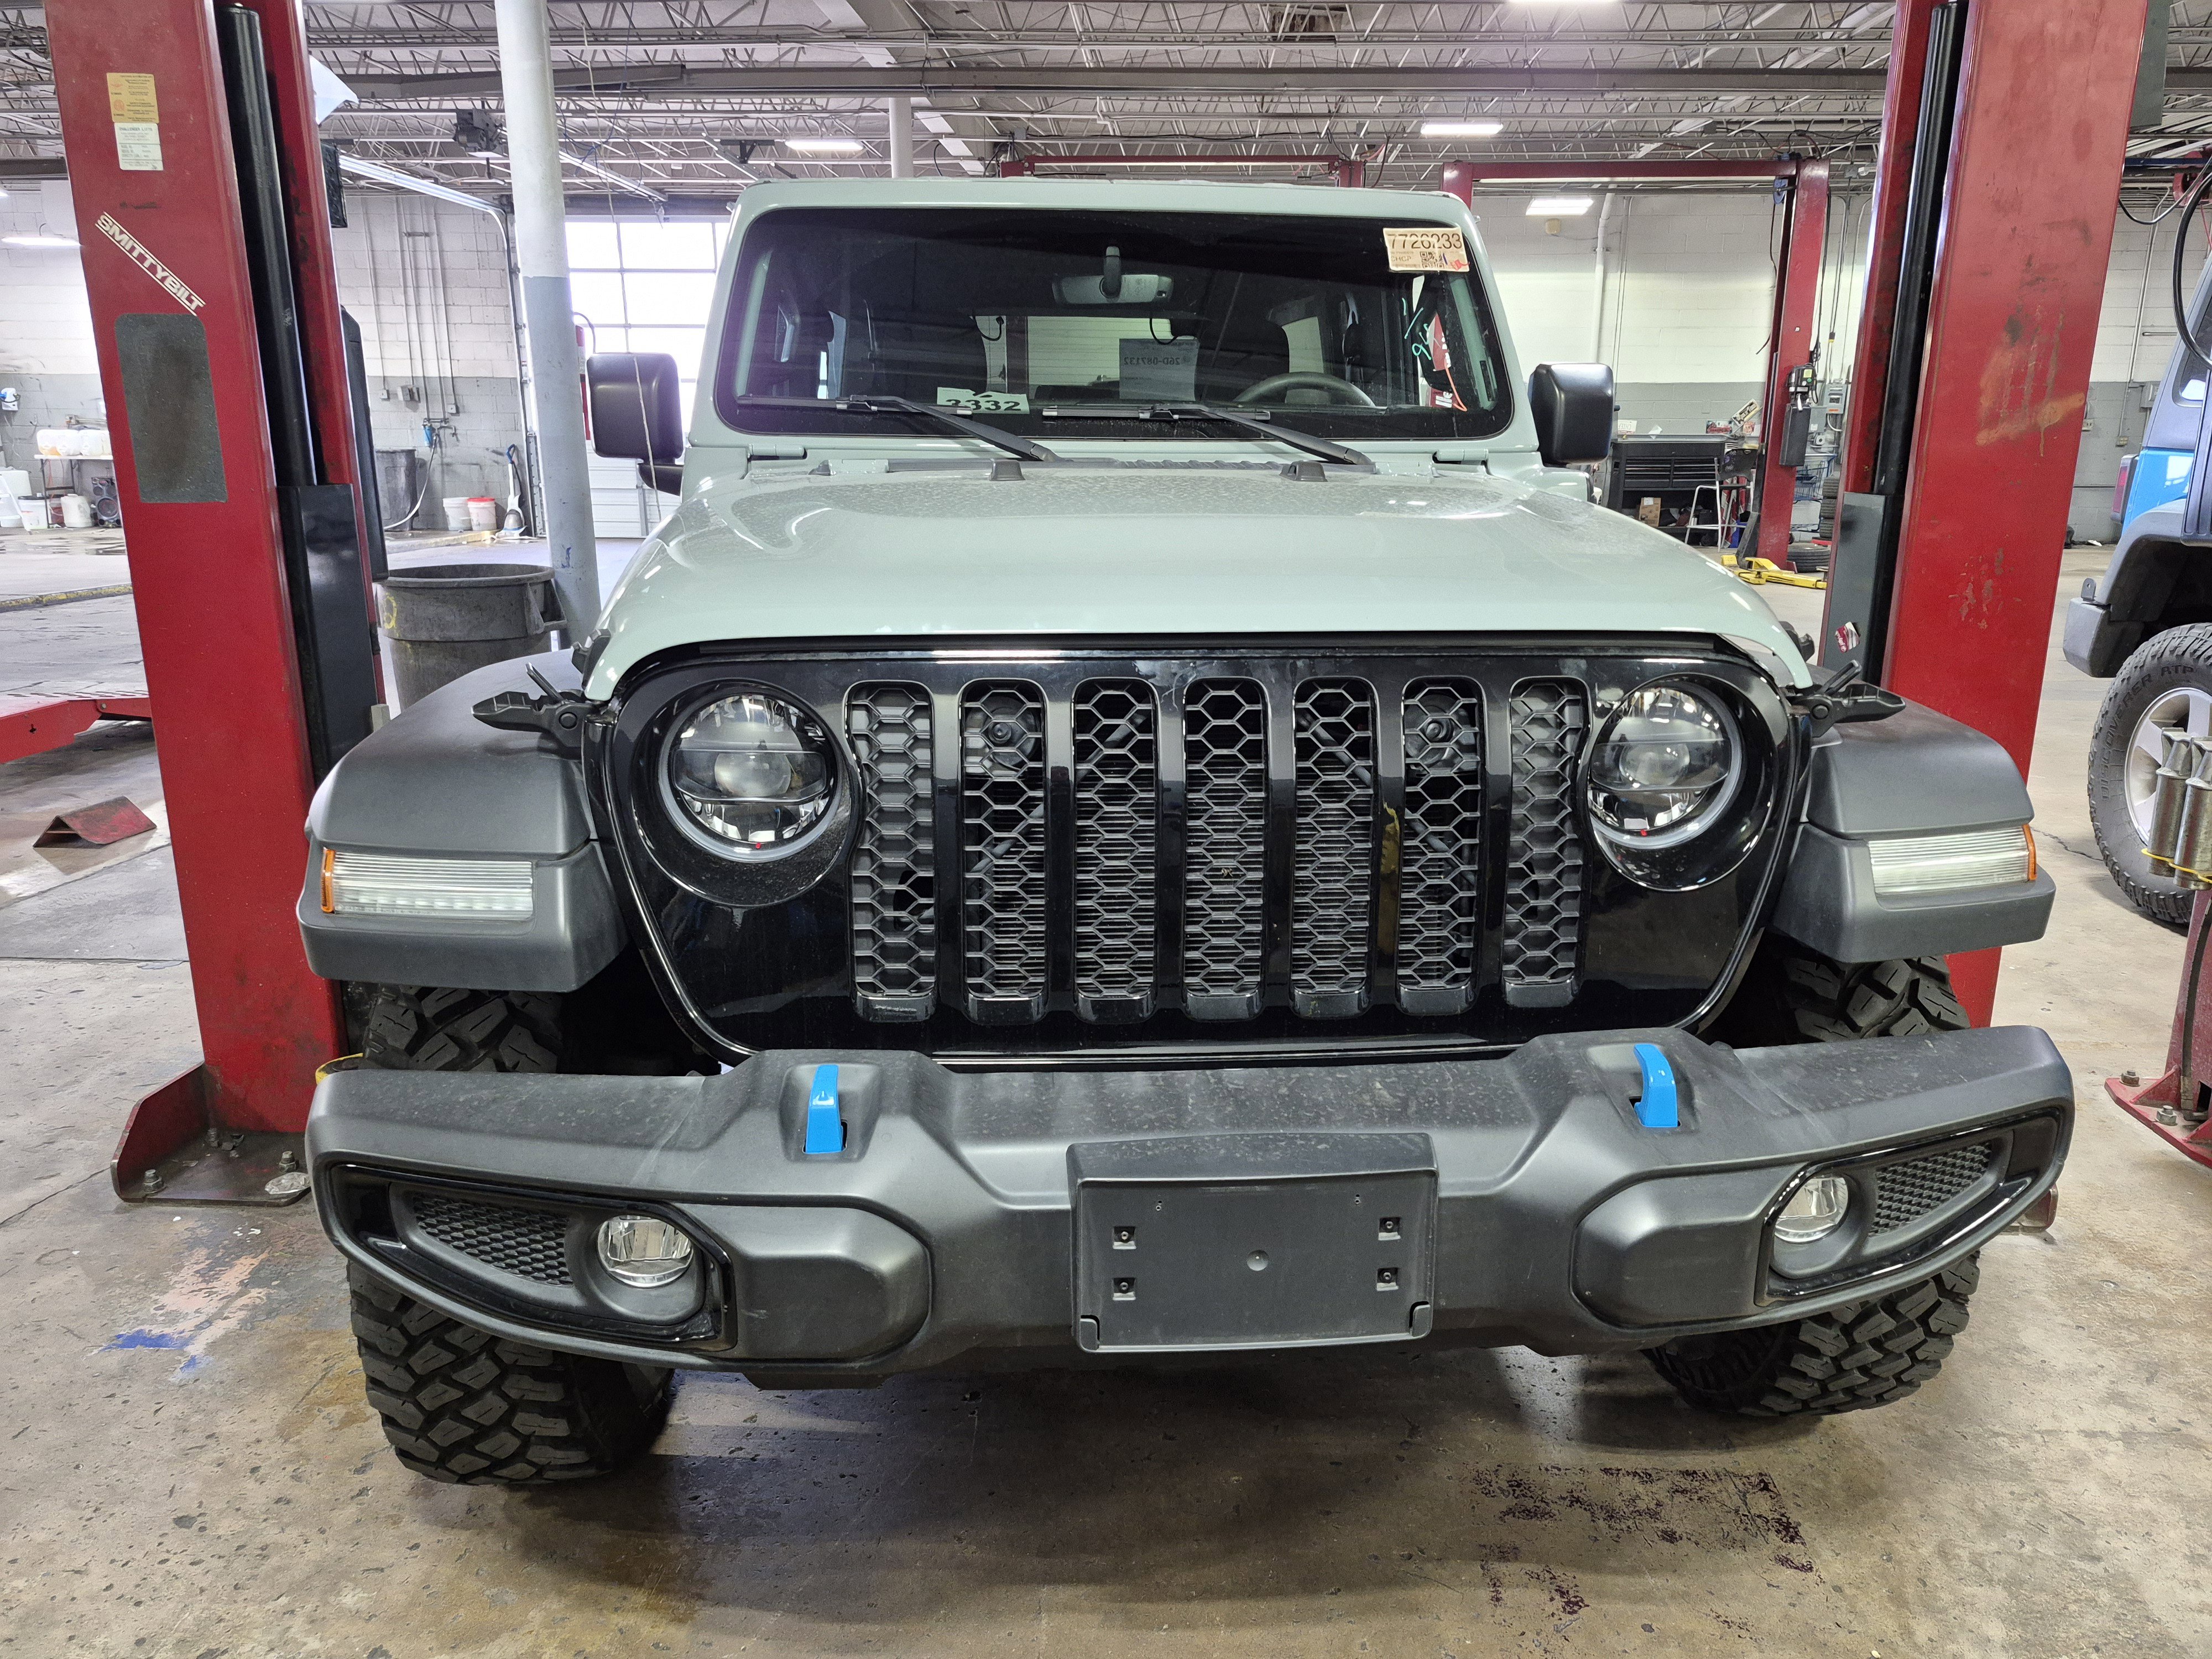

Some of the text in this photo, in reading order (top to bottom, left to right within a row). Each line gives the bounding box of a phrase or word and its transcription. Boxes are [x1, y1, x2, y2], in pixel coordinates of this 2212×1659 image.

[1387, 233, 1462, 249] 7726233
[97, 215, 205, 310] SMITTYBILT
[2161, 665, 2193, 677] ATP
